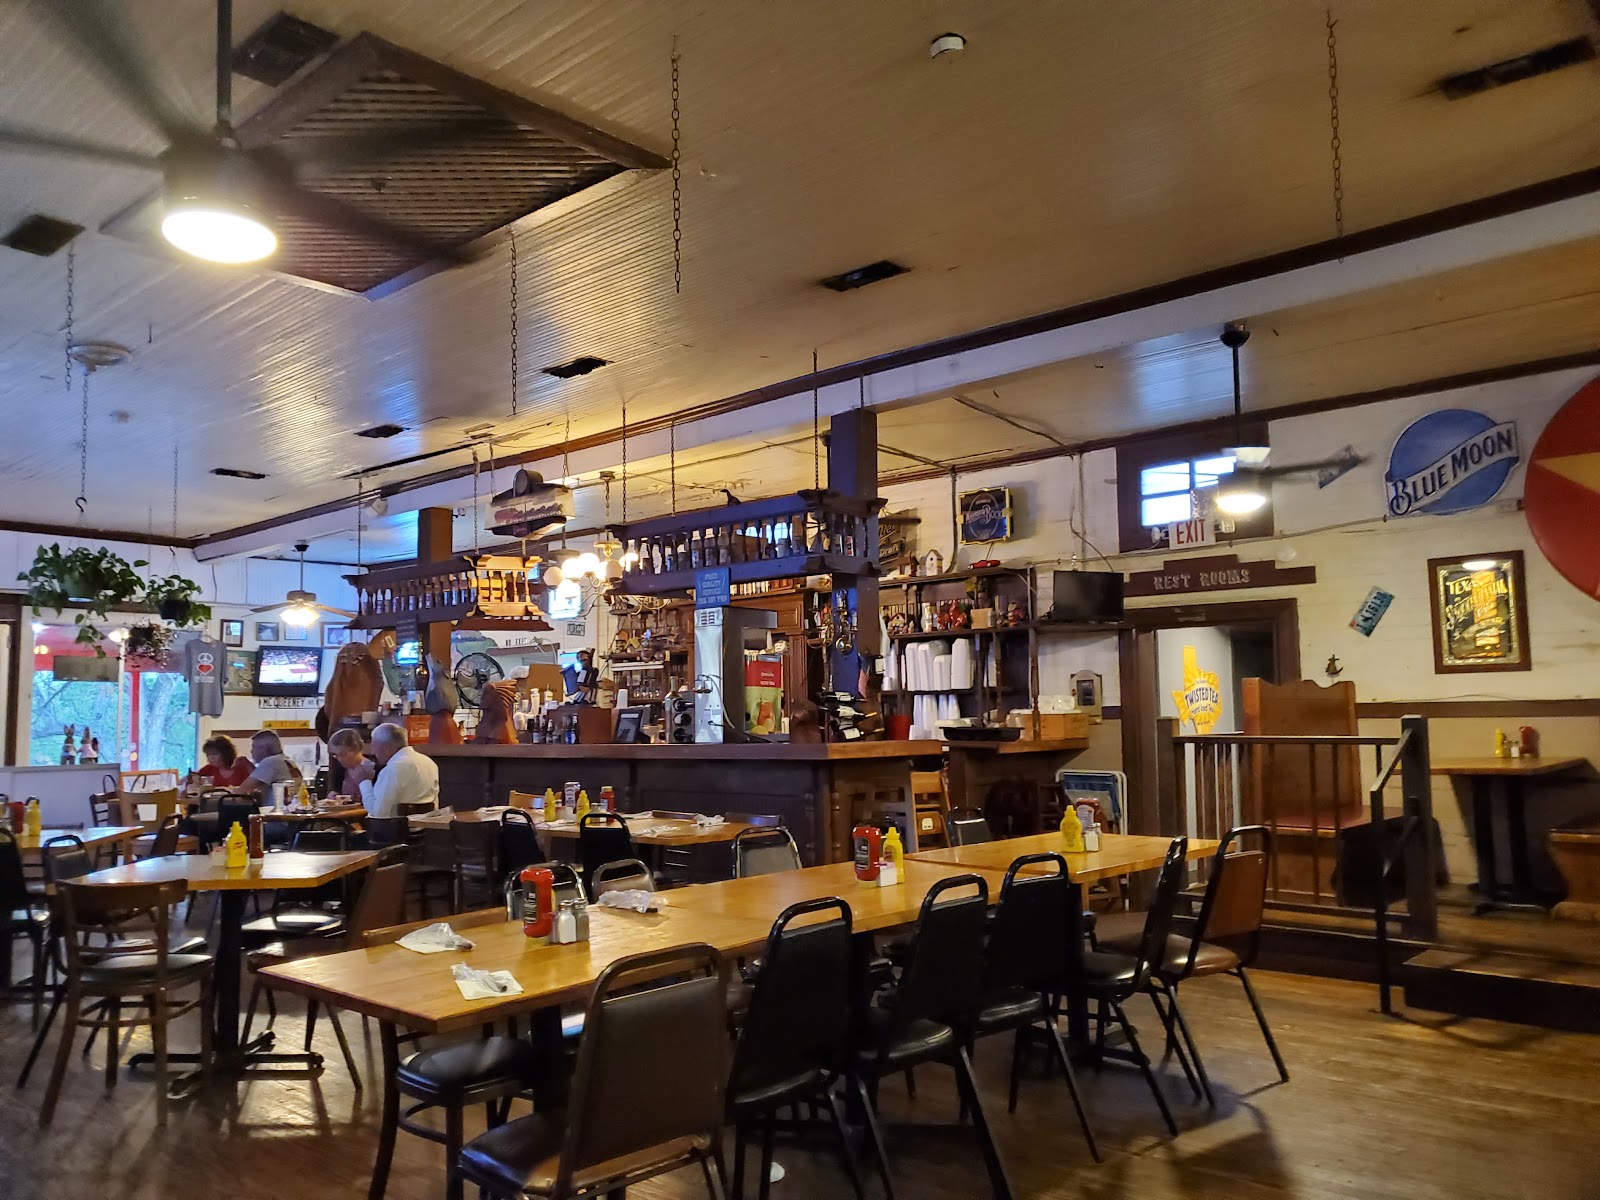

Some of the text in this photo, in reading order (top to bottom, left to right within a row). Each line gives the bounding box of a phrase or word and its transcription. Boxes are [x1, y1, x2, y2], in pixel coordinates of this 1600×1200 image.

[1390, 429, 1514, 516] BLUE MOON
[1176, 518, 1206, 545] EXIT
[1153, 568, 1250, 590] REST ROOMS
[1185, 687, 1209, 709] TWISTED
